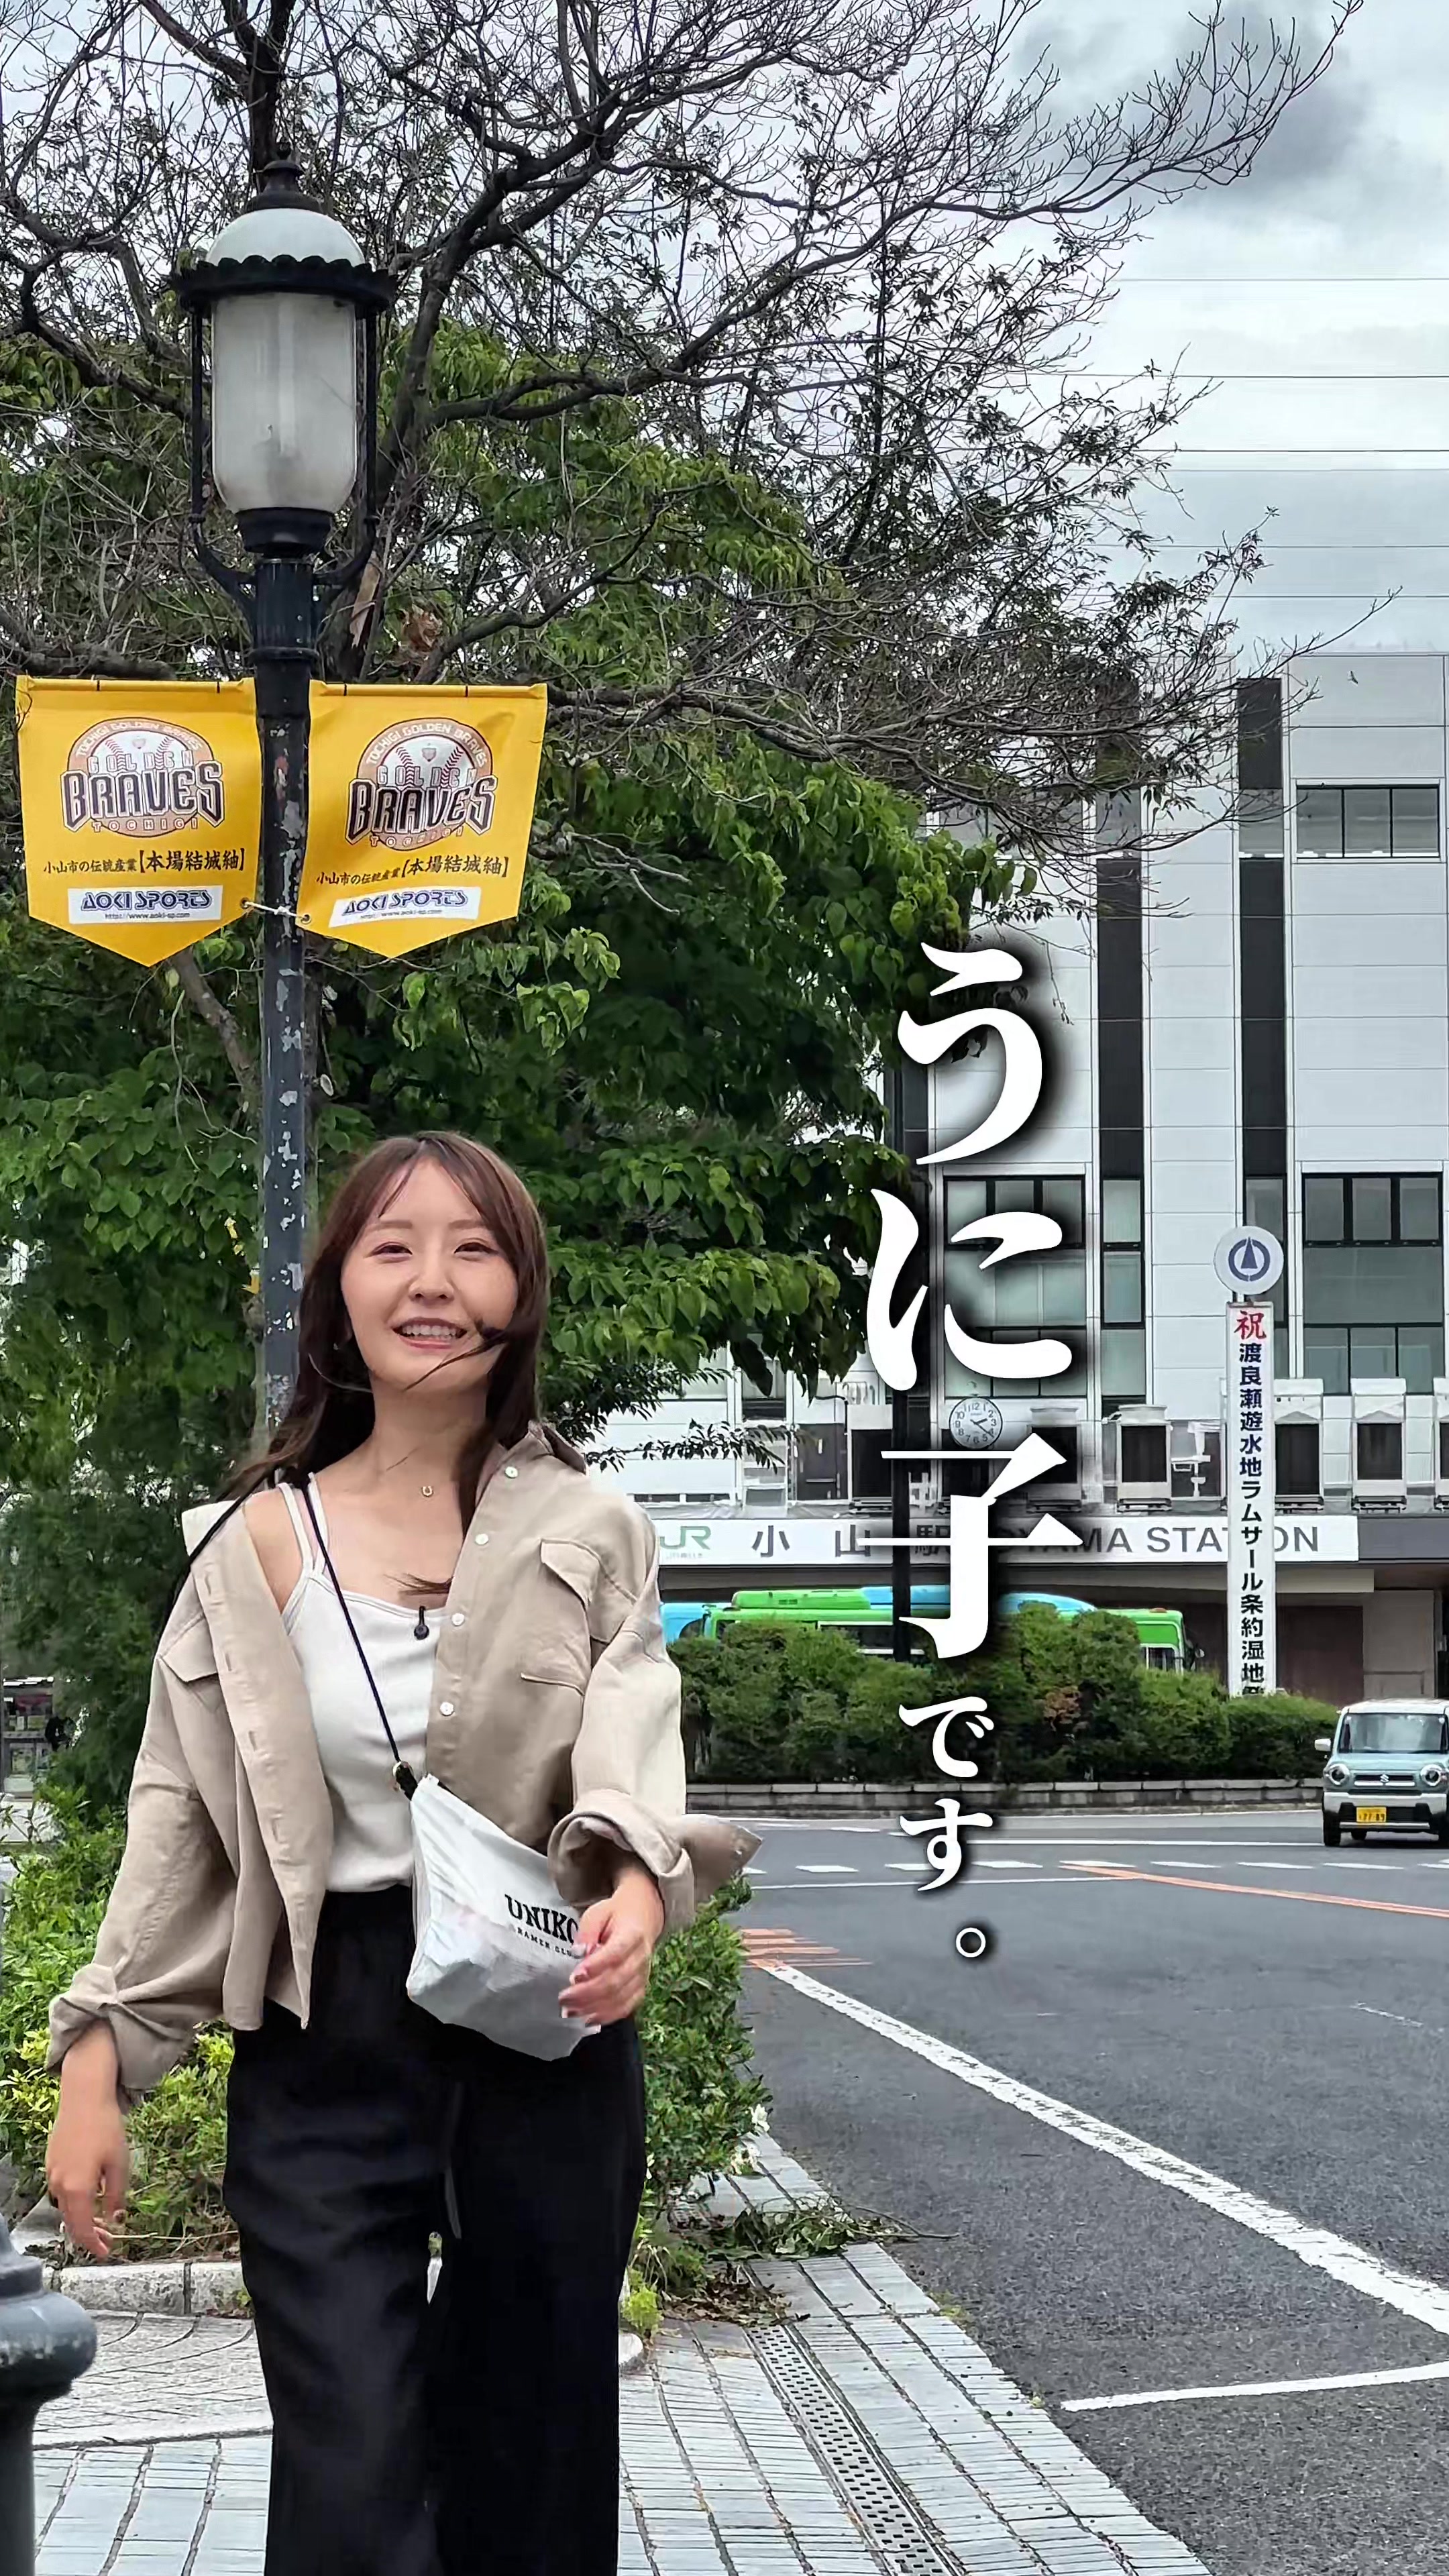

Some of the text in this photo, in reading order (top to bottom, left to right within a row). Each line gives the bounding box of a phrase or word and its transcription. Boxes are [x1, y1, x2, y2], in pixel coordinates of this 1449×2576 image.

[366, 722, 488, 768] TOCHIGI GOLDEN BRAVES
[87, 749, 194, 774] GOLDEN
[377, 765, 477, 787] GOLDEN
[61, 759, 225, 833] BRAVES
[345, 775, 498, 845] BRAVES
[93, 818, 198, 833] TOCHIGI
[80, 890, 212, 911] AOKI SPORTS
[341, 889, 468, 916] AOKI SPORTS
[1234, 1310, 1267, 1340] 祝
[659, 1525, 711, 1550] JR
[1146, 1526, 1319, 1553] STAON
